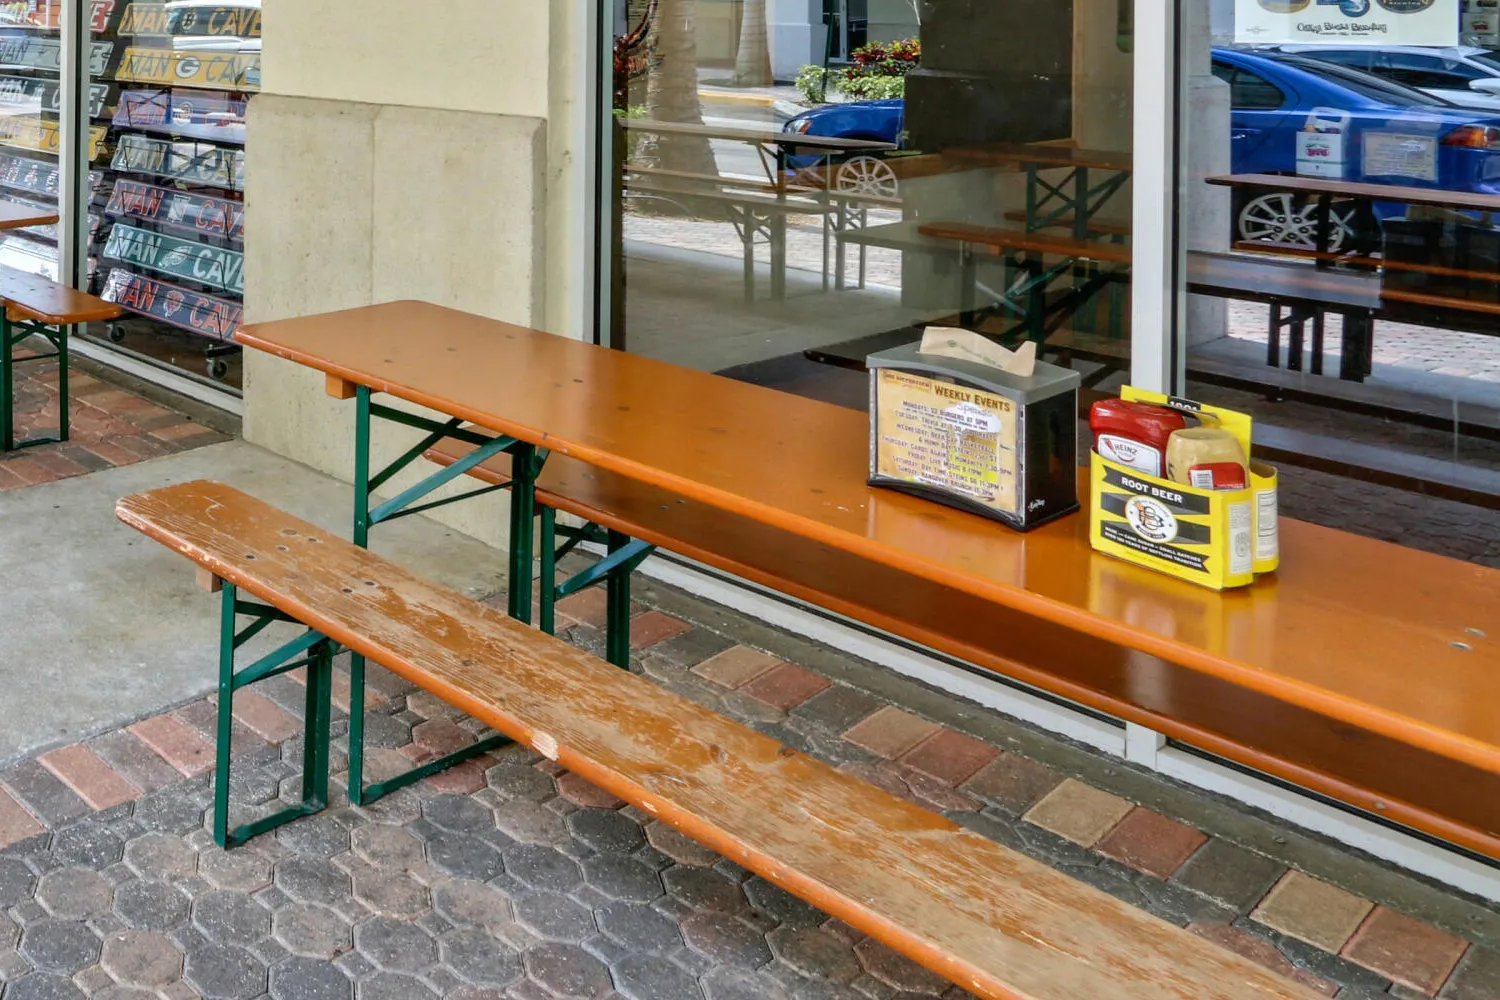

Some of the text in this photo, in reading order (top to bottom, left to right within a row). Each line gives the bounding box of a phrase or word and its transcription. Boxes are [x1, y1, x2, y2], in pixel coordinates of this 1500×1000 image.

[125, 54, 171, 78] MAN
[122, 185, 164, 217] MAN
[115, 230, 162, 265] MAN
[935, 385, 1010, 412] WEEKLY EVENTS
[1114, 444, 1138, 455] HEINZ
[1121, 476, 1183, 503] ROOT BEER
